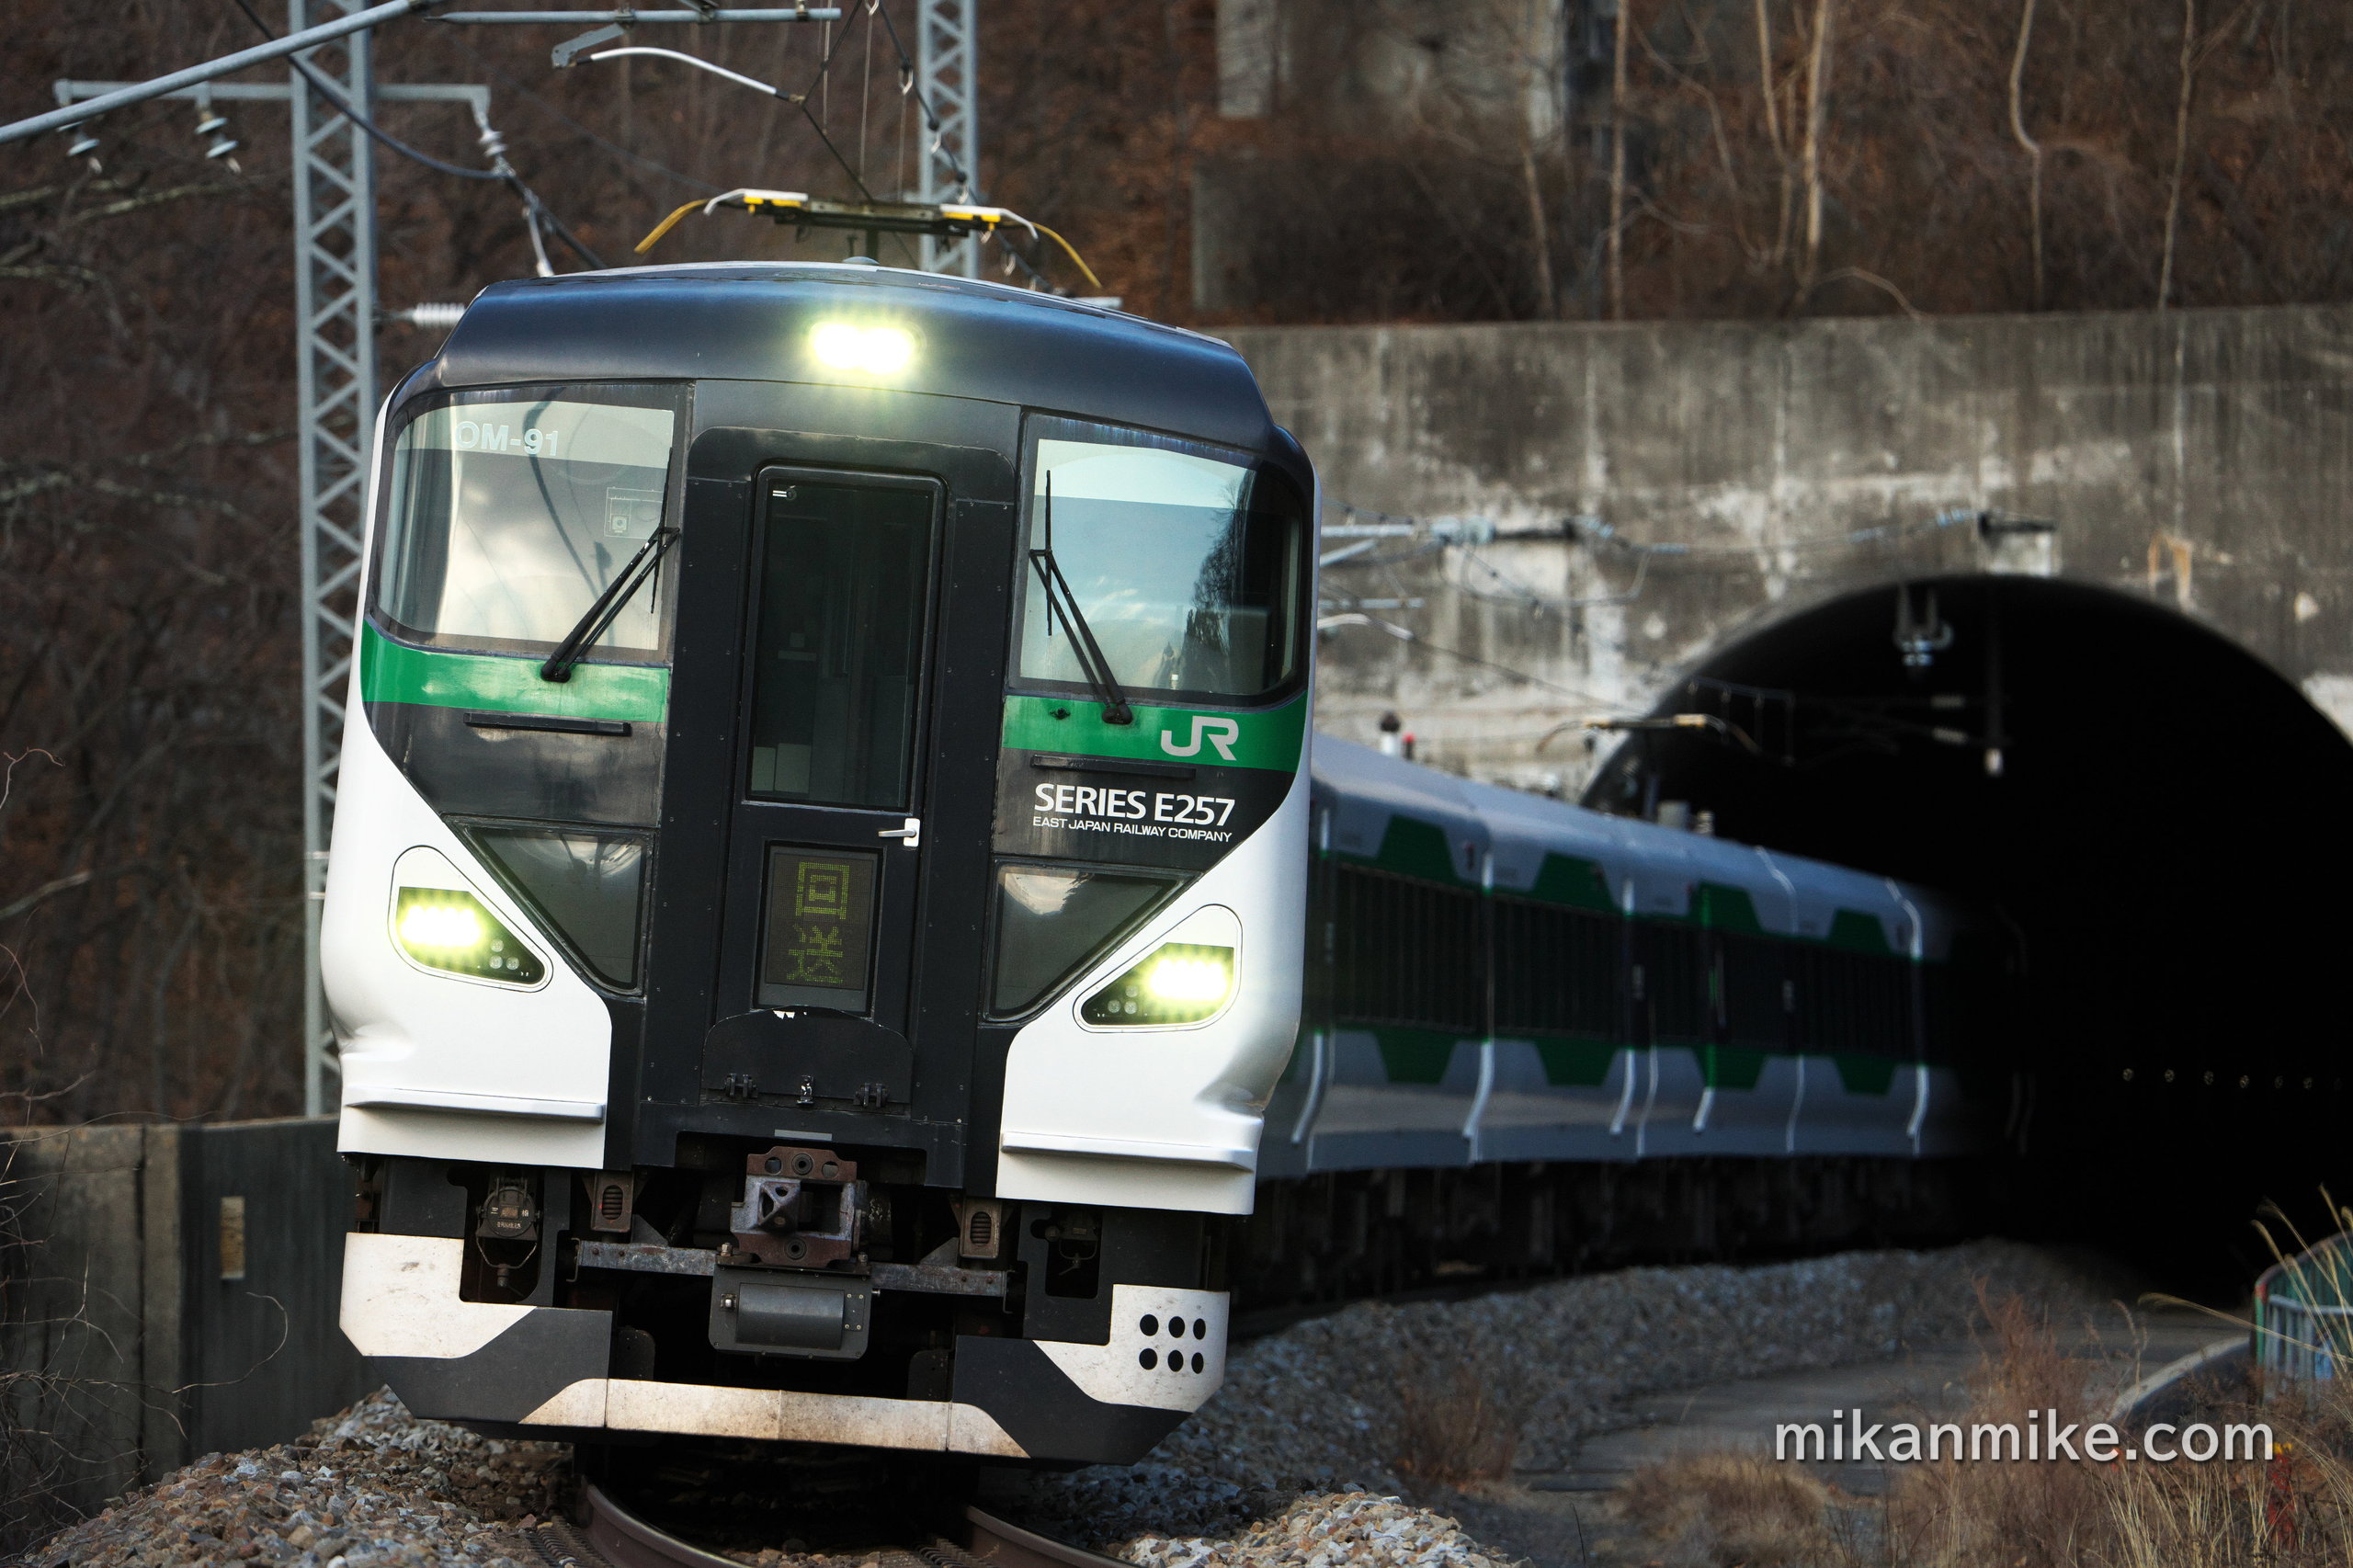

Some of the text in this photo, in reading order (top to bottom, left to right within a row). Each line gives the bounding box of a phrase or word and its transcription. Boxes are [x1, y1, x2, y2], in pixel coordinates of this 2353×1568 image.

[455, 421, 559, 456] OM-91
[1161, 716, 1239, 760] JR
[1034, 783, 1235, 826] SERIES E257
[1033, 817, 1233, 842] EAST JAPAN RAILWAY COMPANY
[787, 862, 849, 983] 回送
